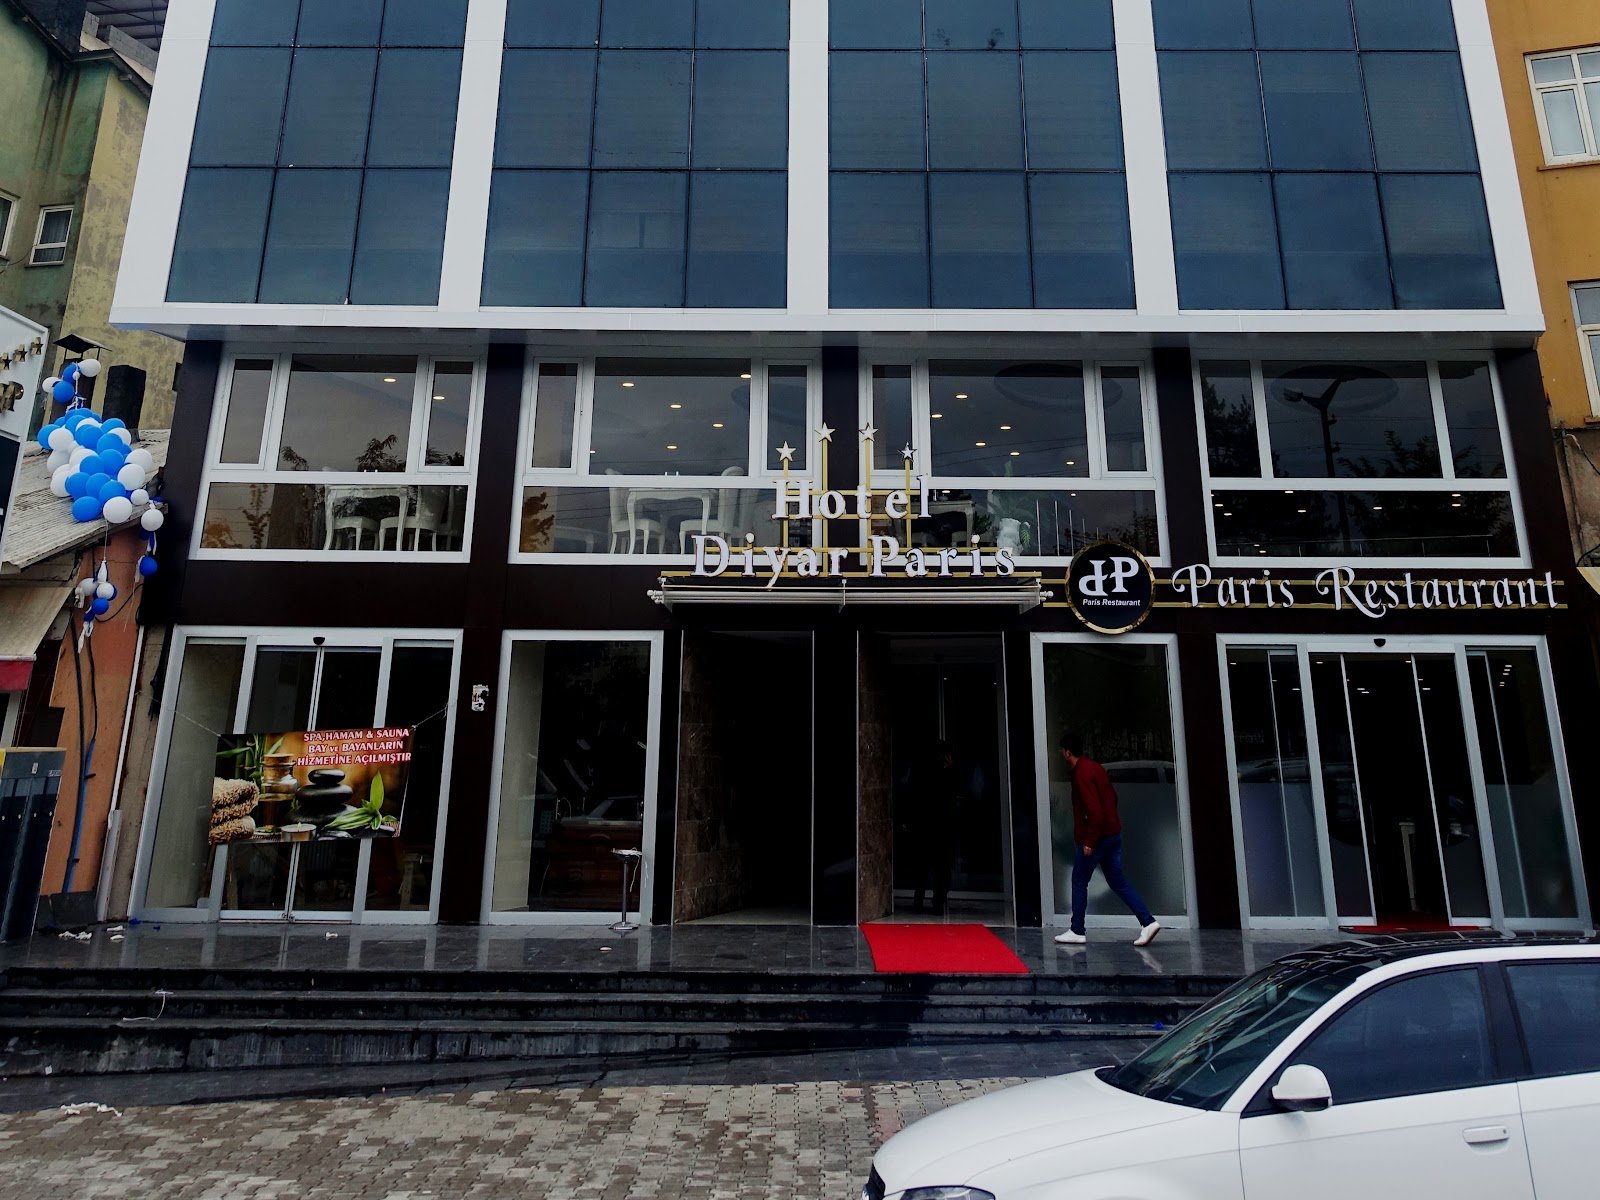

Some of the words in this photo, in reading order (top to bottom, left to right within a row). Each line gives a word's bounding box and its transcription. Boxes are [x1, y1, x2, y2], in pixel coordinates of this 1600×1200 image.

[771, 474, 931, 520] Hotel
[691, 532, 848, 590] Diyar
[868, 534, 1015, 577] Paris
[1171, 563, 1295, 608] Paris
[1315, 566, 1559, 619] Restaurant
[1082, 598, 1100, 606] Paris
[1102, 598, 1140, 606] Restaurant
[366, 730, 374, 739] &
[376, 728, 410, 738] SAUNA
[308, 744, 328, 753] BAY
[342, 741, 404, 752] BAYANLARIN
[297, 754, 352, 766] HİZMETİNE
[354, 752, 412, 766] AÇILMIŞTIR
